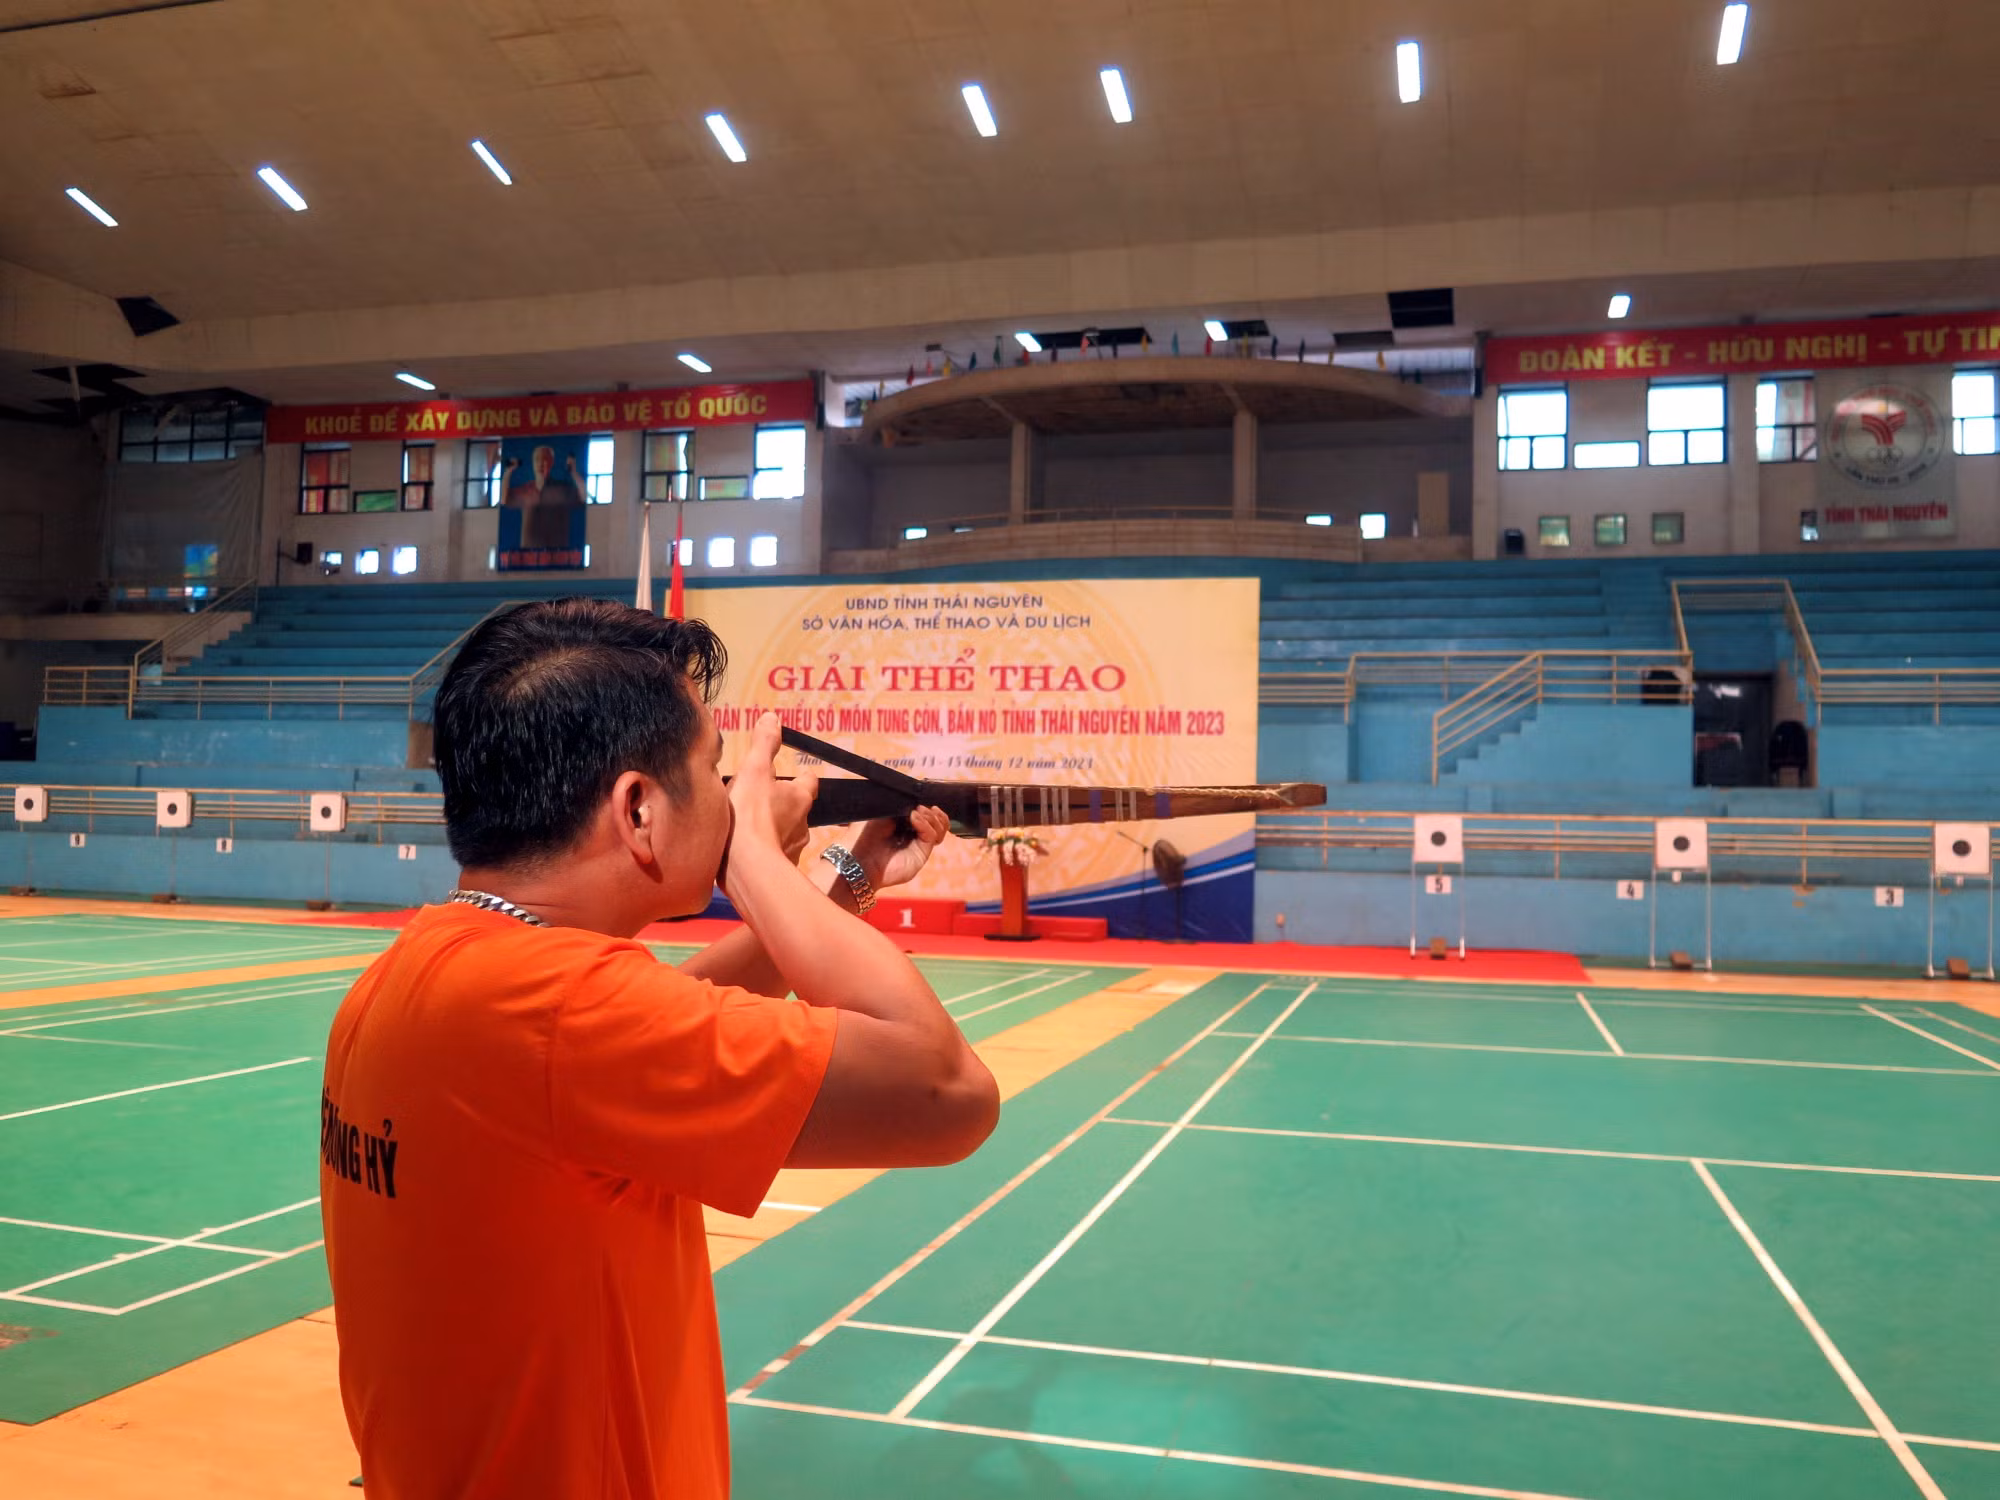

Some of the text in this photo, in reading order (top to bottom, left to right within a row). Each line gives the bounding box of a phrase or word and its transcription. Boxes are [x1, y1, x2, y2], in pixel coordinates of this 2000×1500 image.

[1519, 344, 1605, 373] ĐOÀN
[1615, 338, 1675, 369] KẾT
[1708, 333, 1774, 364] HỮU
[1785, 334, 1868, 362] NGHỊ
[1903, 327, 1949, 358] TỰ
[405, 408, 450, 431] XÂY
[456, 408, 521, 432] DỰNG
[529, 403, 559, 427] VÀ
[567, 398, 616, 425] BẢO
[623, 398, 652, 425] VỆ
[661, 393, 691, 419] TỔ
[699, 389, 768, 419] QUỐC
[846, 593, 1043, 610] UBND TỈNH THÁI NGUYÊN
[802, 615, 823, 631] SỞ
[829, 615, 863, 630] VĂN
[915, 611, 942, 630] THỂ
[946, 616, 991, 629] THAO
[996, 613, 1019, 628] VÀ
[1025, 616, 1048, 628] DU
[1053, 614, 1090, 630] LỊCH
[767, 648, 1127, 692] GIẢI THỂ THAO
[714, 703, 740, 731] DÂN
[816, 702, 835, 732] SỐ
[839, 703, 871, 733] MÔN
[877, 708, 909, 733] TUNG
[1002, 699, 1035, 734] TỈNH
[1041, 703, 1074, 734] THÁI
[1078, 704, 1140, 735] NGUYÊN
[1145, 703, 1181, 735] NĂM
[1187, 710, 1225, 736] 2023
[965, 754, 1003, 770] tháng
[1008, 756, 1024, 768] 12
[1027, 757, 1056, 768] năm
[899, 908, 916, 928] 1
[364, 1118, 398, 1198] HỶ
